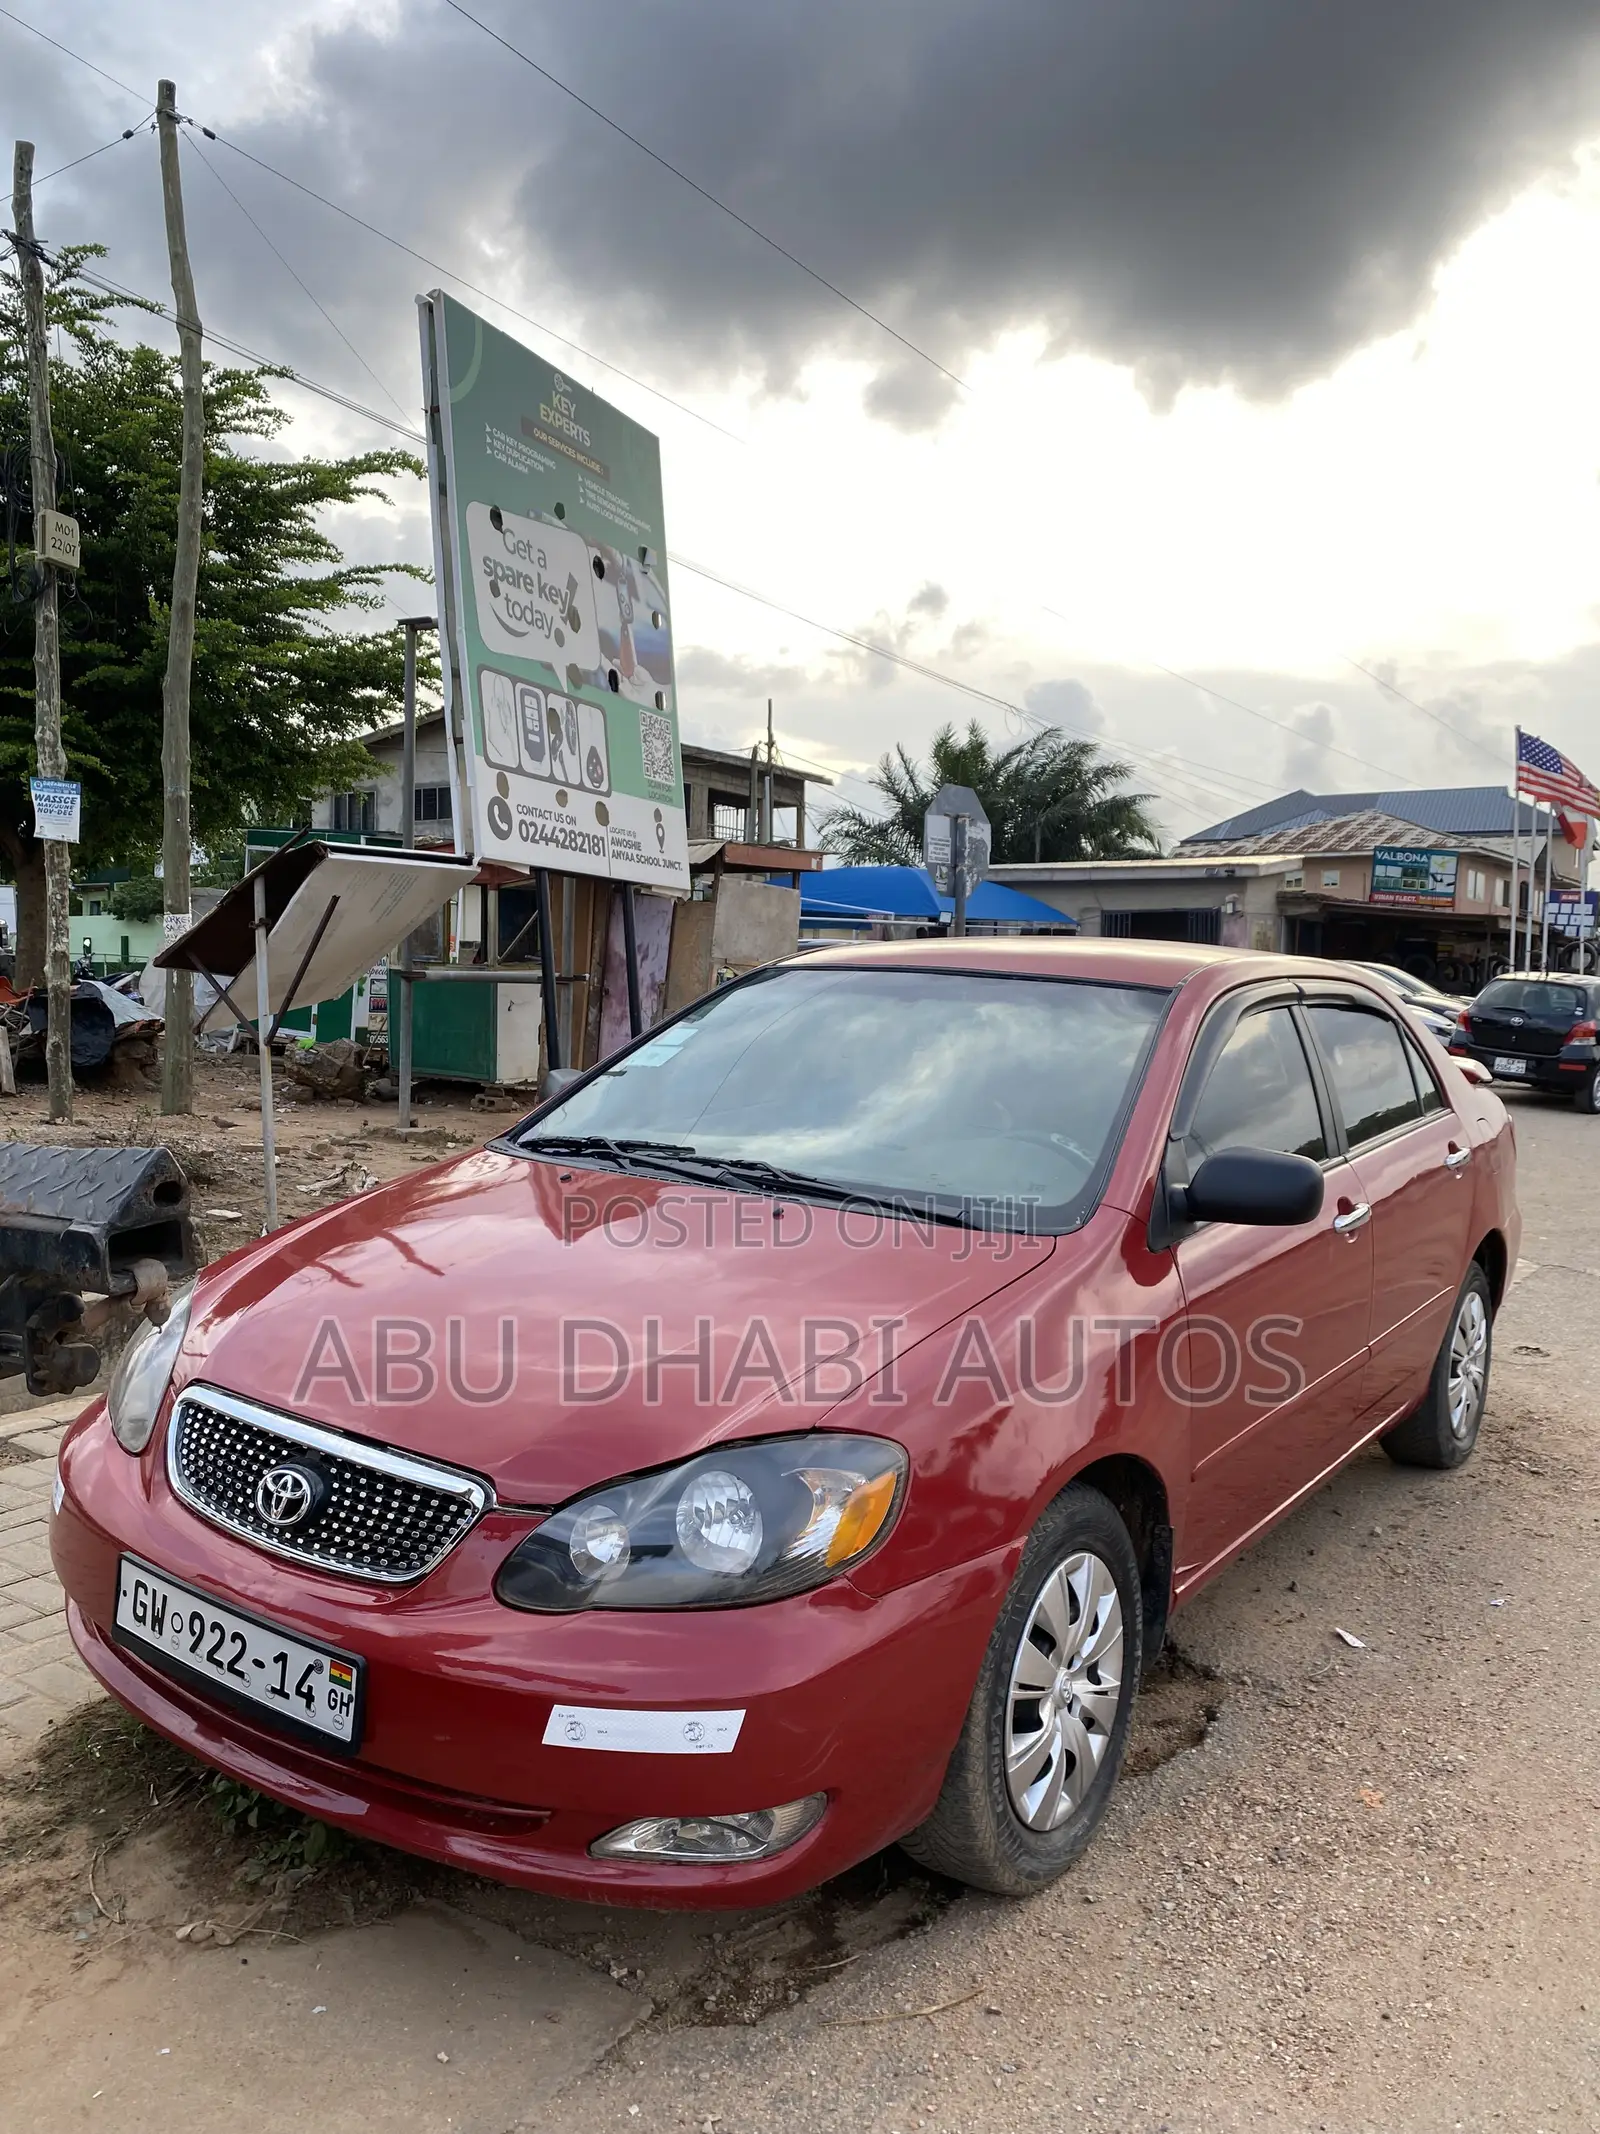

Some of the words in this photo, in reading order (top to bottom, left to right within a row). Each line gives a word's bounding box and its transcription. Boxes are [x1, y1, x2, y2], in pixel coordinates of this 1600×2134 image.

[552, 390, 576, 419] KEY
[540, 403, 591, 447] EXPERTS
[492, 428, 505, 440] CAR
[506, 434, 518, 447] KEY
[533, 428, 547, 442] OUR
[547, 436, 576, 459] SERVICES
[493, 438, 506, 451] KEY
[506, 446, 544, 472] DUPLICATION
[494, 450, 507, 463] CAR
[507, 457, 528, 474] ALARM
[51, 536, 76, 557] 22/07
[502, 528, 534, 564] Get
[537, 548, 547, 570] a
[482, 555, 535, 595] spare
[537, 572, 568, 615] key
[504, 593, 553, 640] today
[35, 793, 78, 805] WASSCE
[37, 802, 74, 810] MAY/JUNE
[37, 807, 73, 816] NOV-DEC
[516, 804, 553, 820] CONTACT
[554, 813, 564, 823] US
[565, 815, 577, 826] ON
[518, 819, 606, 857] 0244282181
[609, 826, 626, 835] LOCATE
[610, 836, 642, 851] AWOSHIE
[611, 849, 635, 863] ANYAA
[636, 853, 662, 867] SCHOOL
[662, 859, 683, 871] JUNCT.
[1375, 850, 1429, 863] VALBONA
[132, 1579, 168, 1636] GW
[188, 1610, 316, 1710] 922-14
[327, 1688, 352, 1718] GH
